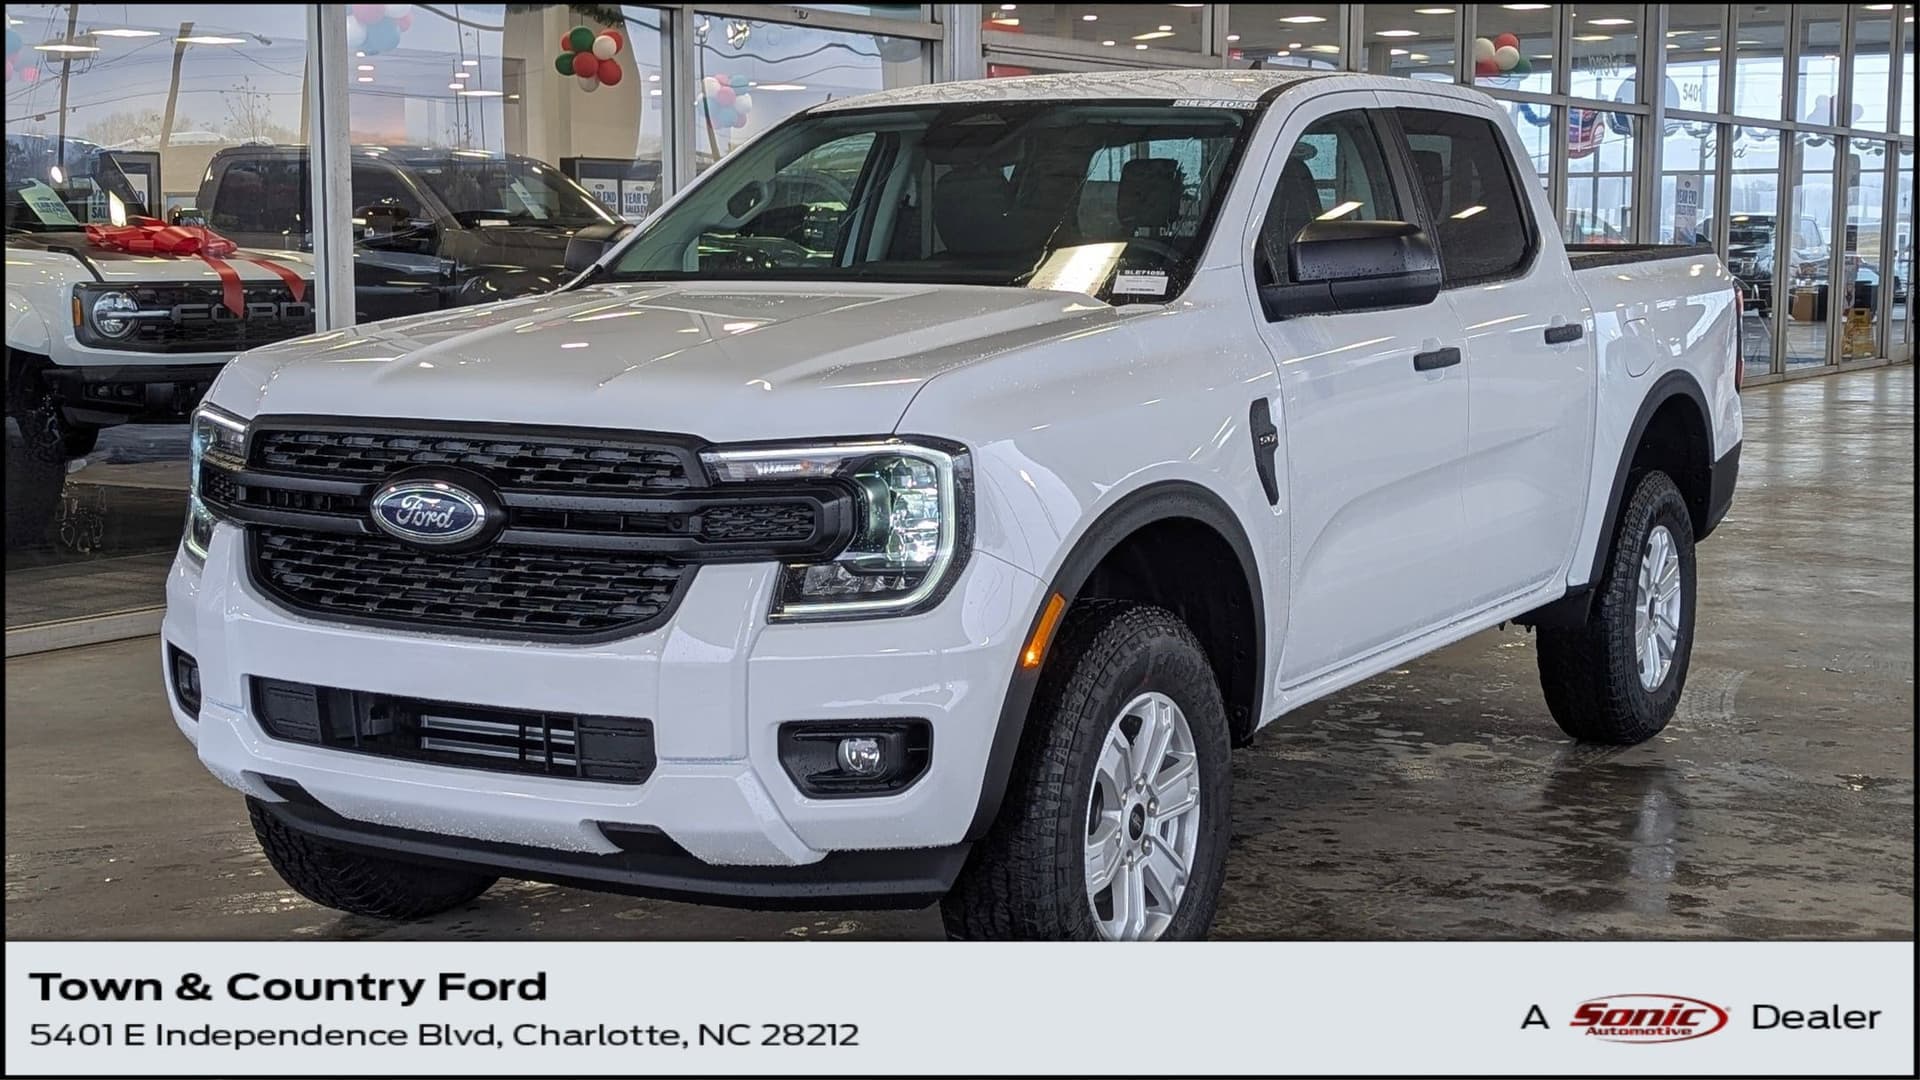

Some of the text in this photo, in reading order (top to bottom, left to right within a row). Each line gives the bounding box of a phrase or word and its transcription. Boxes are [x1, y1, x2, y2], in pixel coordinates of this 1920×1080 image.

[1682, 83, 1703, 103] 5401
[172, 302, 311, 324] FORD
[396, 494, 454, 529] Ford
